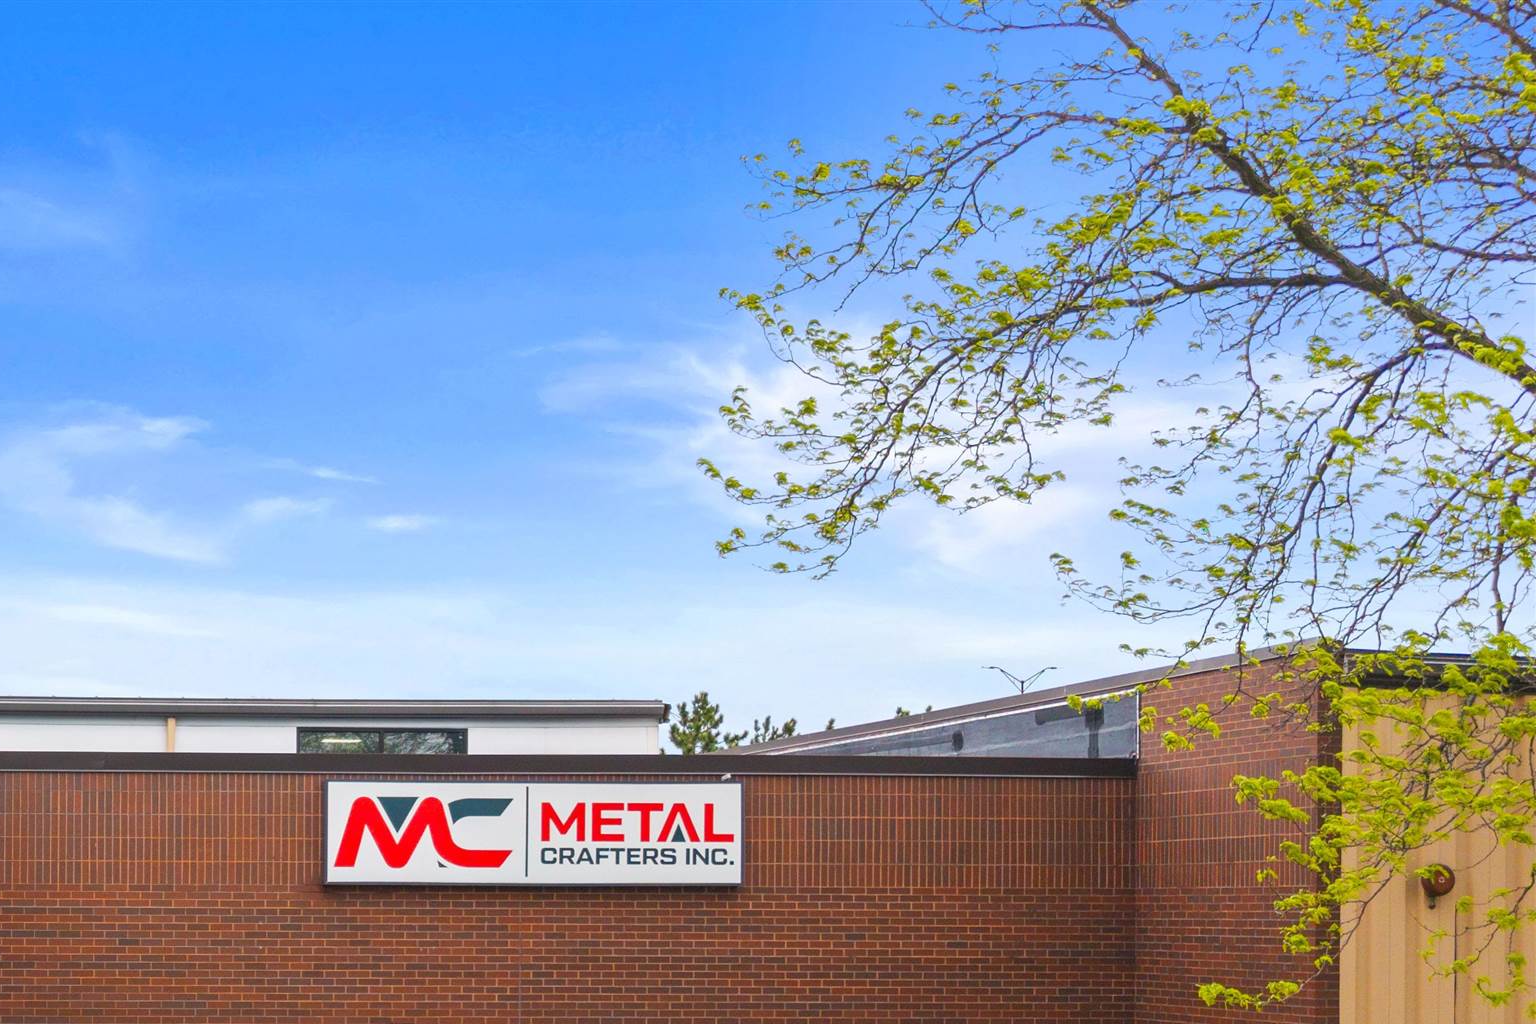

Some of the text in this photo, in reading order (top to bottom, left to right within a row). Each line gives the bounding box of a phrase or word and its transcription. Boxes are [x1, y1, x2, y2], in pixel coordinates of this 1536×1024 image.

[541, 802, 735, 842] METAL
[540, 847, 735, 866] CRAFTERS INC.
